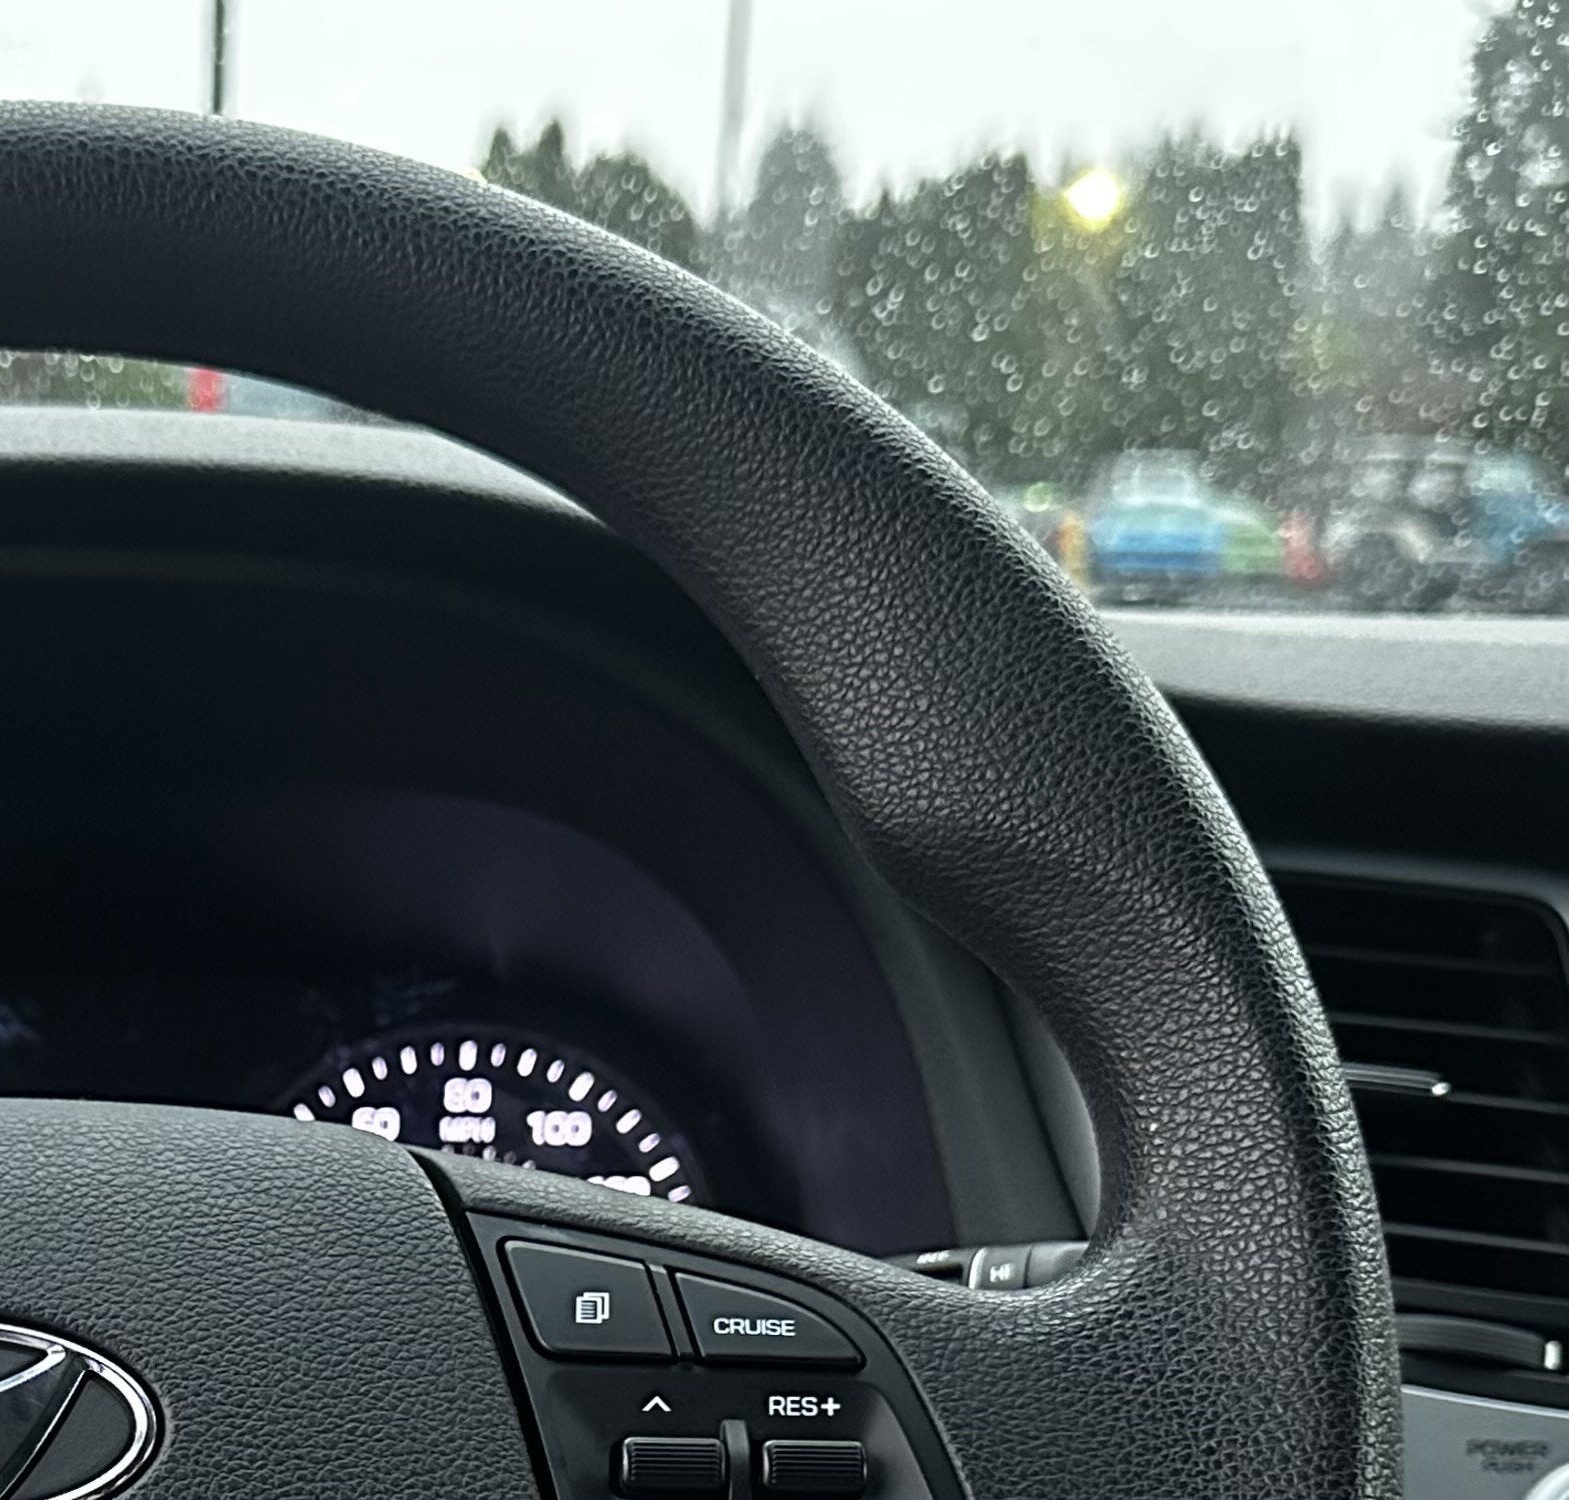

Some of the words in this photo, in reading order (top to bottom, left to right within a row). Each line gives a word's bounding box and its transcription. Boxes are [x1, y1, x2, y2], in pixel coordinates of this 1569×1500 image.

[444, 1077, 492, 1114] 80
[526, 1110, 592, 1147] 100
[713, 1318, 796, 1337] CRUISE
